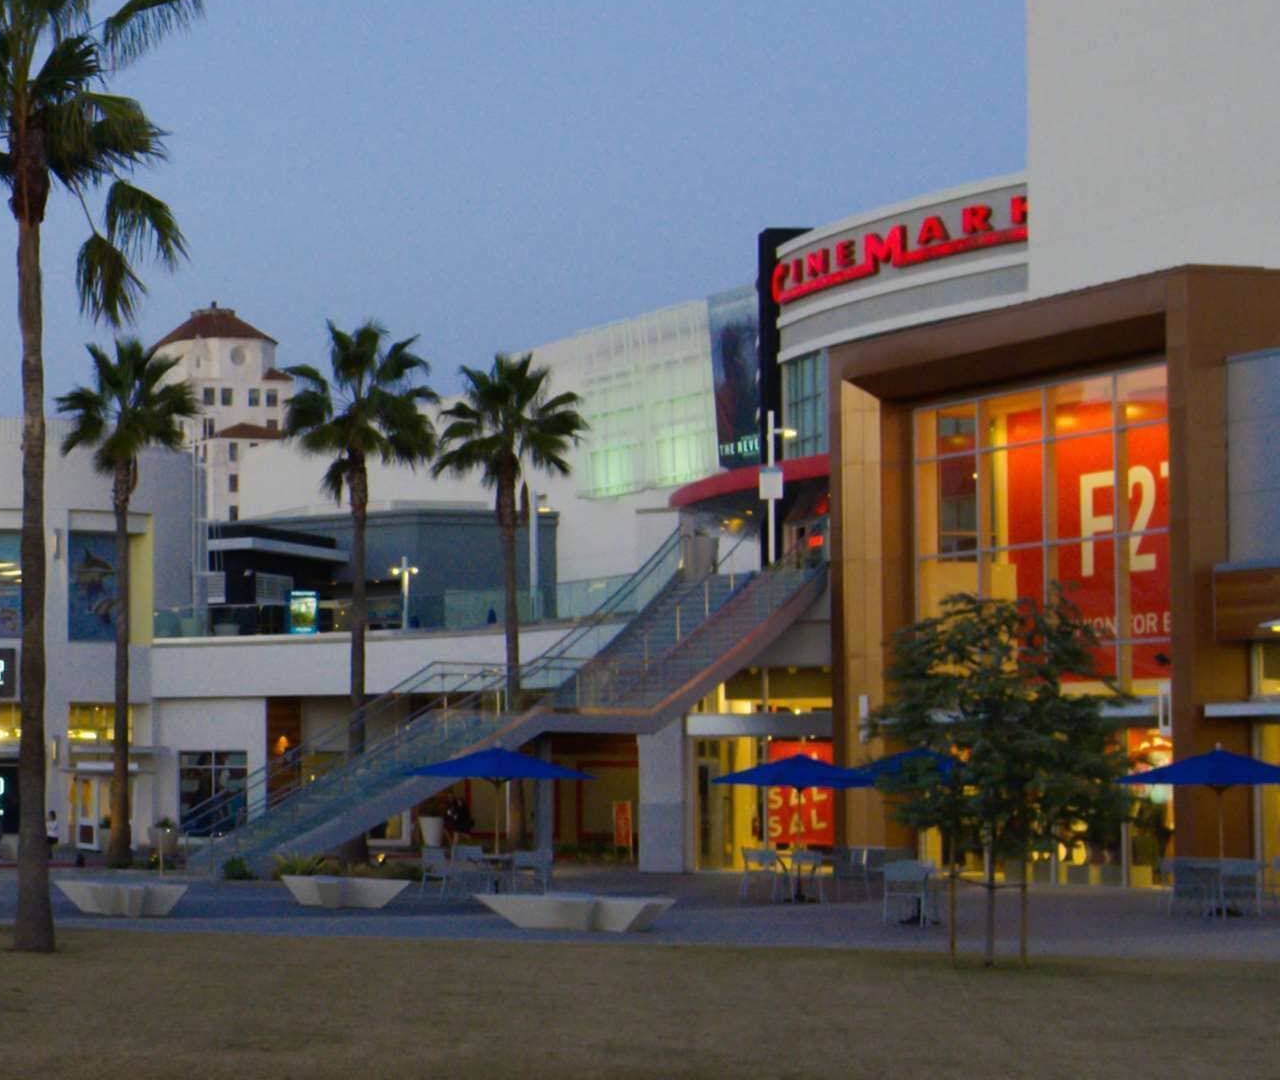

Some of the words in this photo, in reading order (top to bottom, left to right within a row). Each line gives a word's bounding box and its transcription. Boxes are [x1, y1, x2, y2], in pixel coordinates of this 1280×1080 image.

[1080, 461, 1169, 578] F2
[767, 786, 828, 809] SAL
[767, 809, 828, 837] SAL
